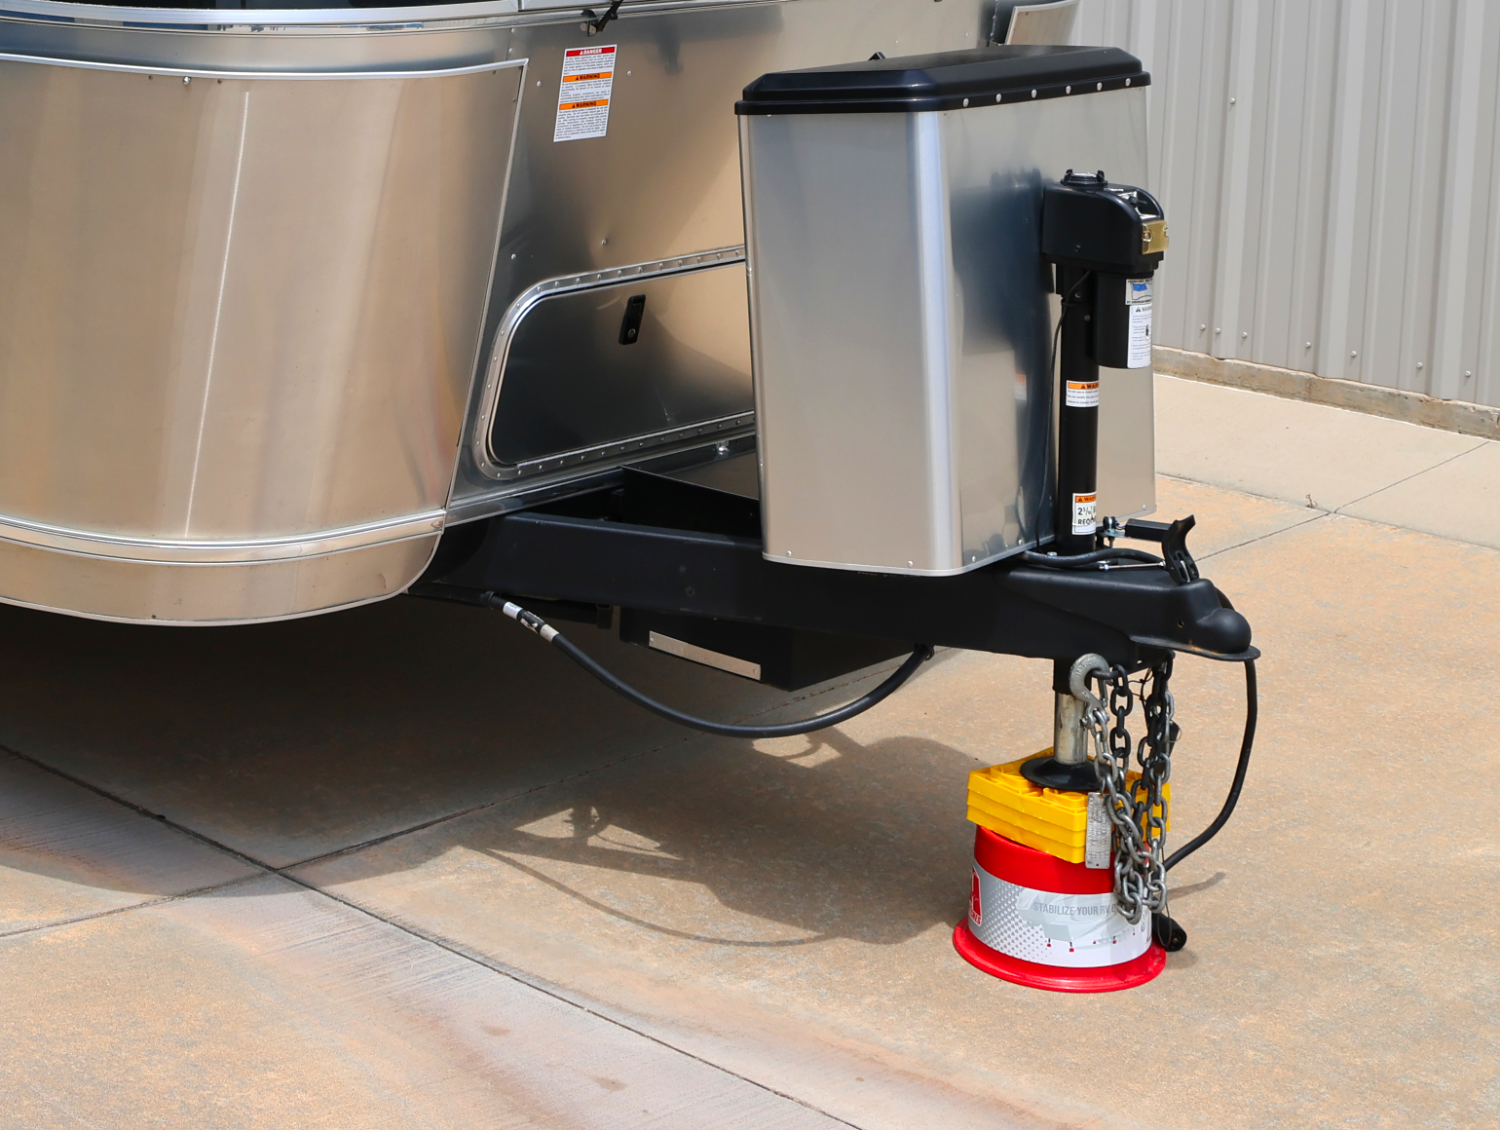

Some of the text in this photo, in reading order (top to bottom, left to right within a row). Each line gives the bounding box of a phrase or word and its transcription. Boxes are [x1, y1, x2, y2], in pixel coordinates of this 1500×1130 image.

[1033, 902, 1075, 916] STABILIZE
[1077, 905, 1099, 916] YOUR
[1100, 904, 1111, 915] RV
